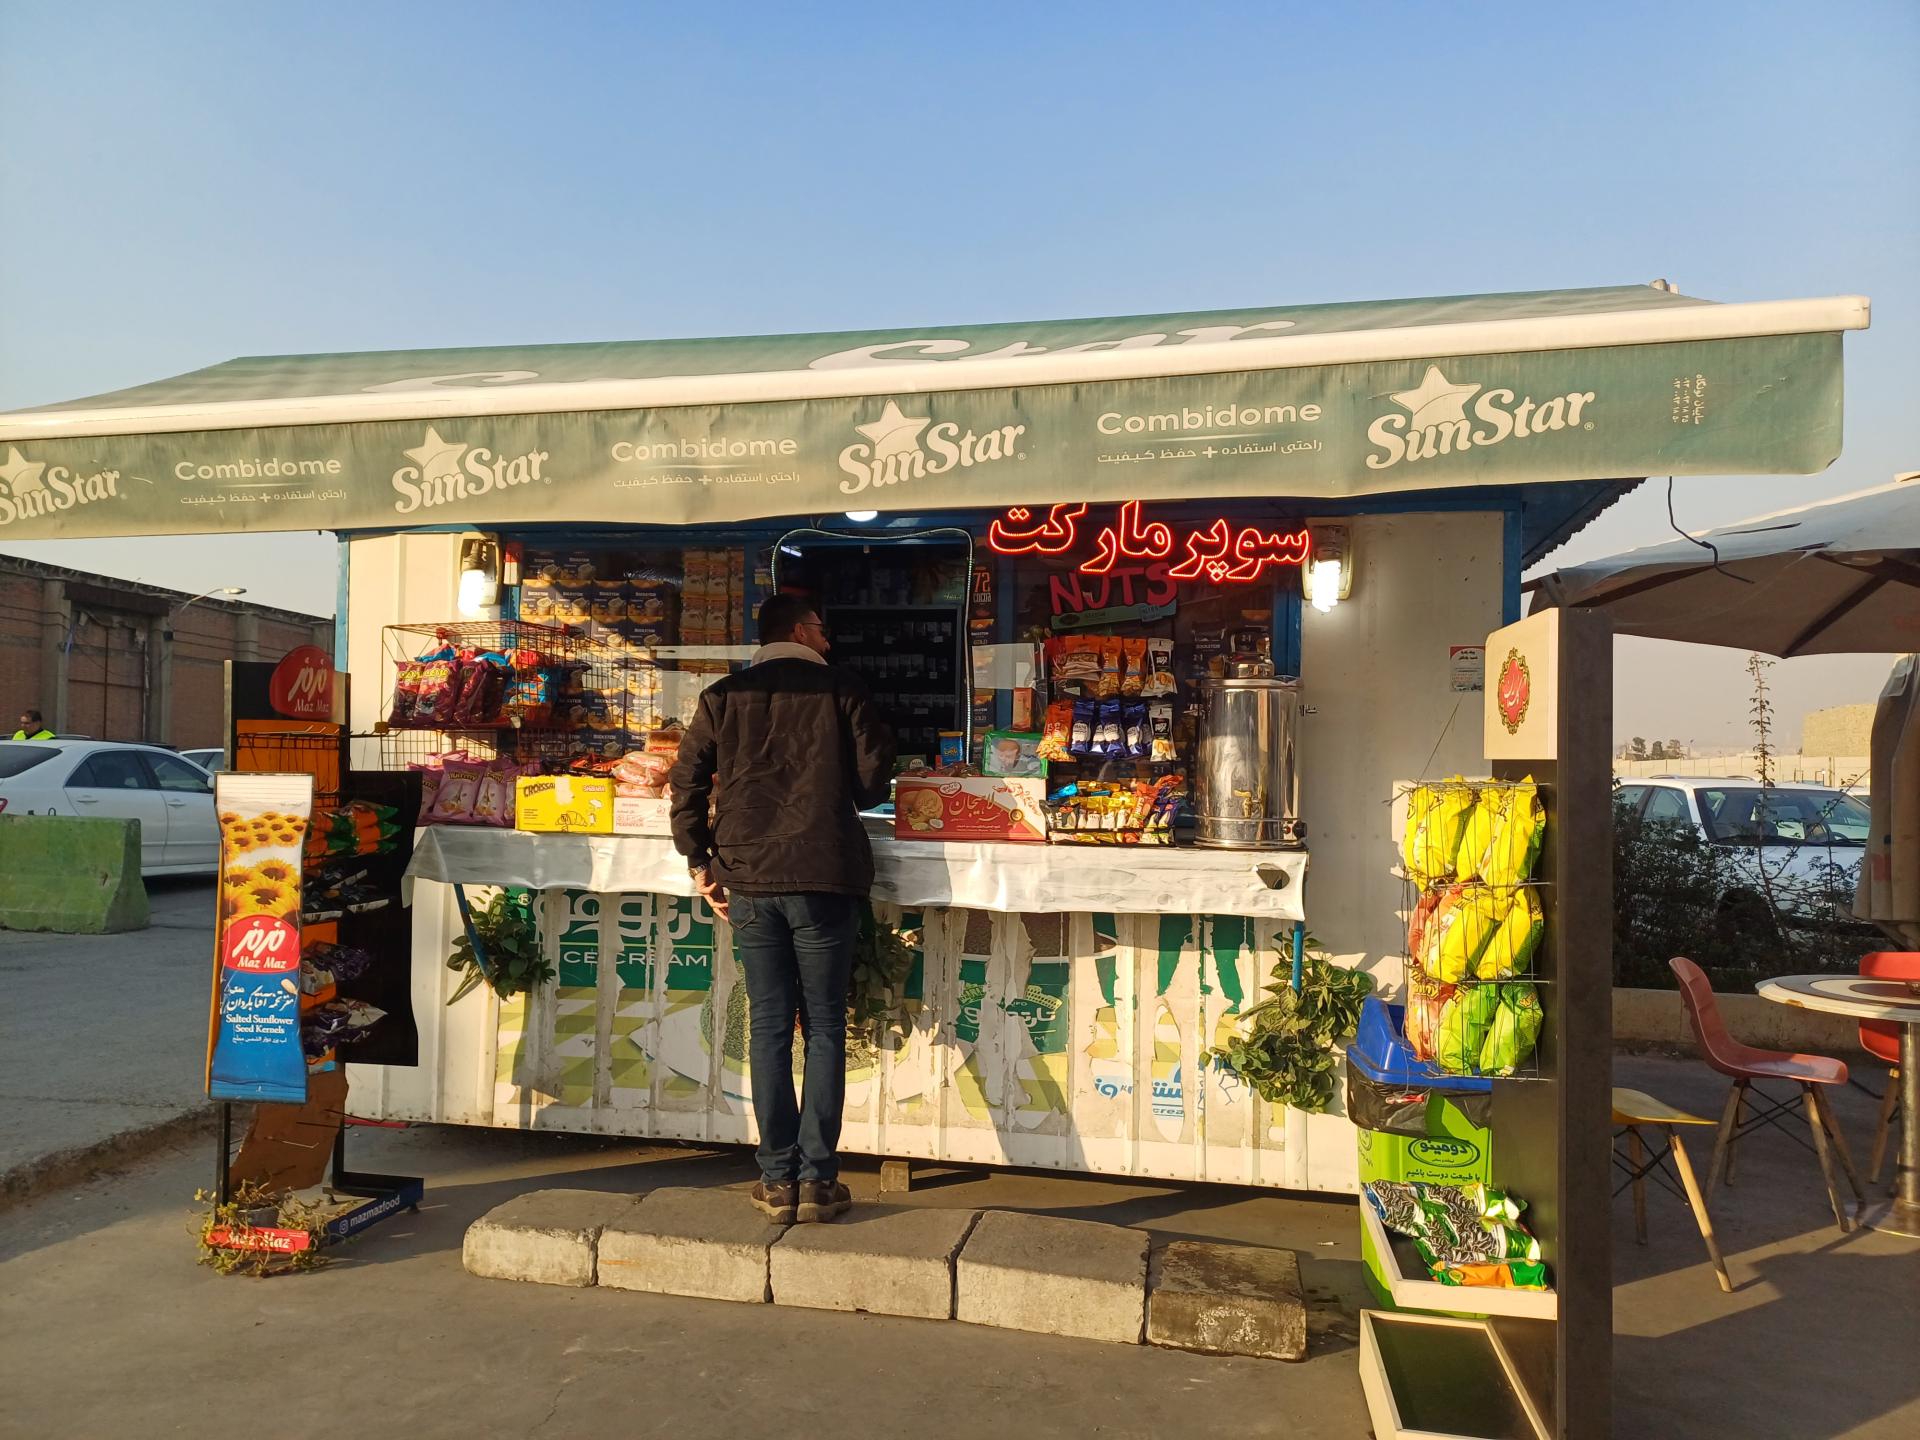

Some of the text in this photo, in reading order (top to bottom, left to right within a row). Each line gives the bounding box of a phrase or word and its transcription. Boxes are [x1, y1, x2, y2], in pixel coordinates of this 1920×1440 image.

[1097, 402, 1322, 435] Combidome
[1366, 388, 1595, 470] SunStar
[611, 437, 798, 463] Combidome
[1159, 445, 1197, 459] حفظ
[1221, 441, 1276, 456] استفاده
[1281, 440, 1323, 456] راحتی
[838, 421, 1025, 494] SunStar
[1097, 448, 1155, 464] کیفیت
[175, 457, 342, 481] Combidome
[392, 447, 549, 513] SunStar
[613, 475, 658, 488] کیفیت
[662, 473, 693, 485] حفظ
[715, 472, 762, 485] استفاده
[766, 471, 800, 484] راحتی
[180, 493, 226, 505] کیفیت
[229, 493, 256, 502] حفظ
[274, 490, 315, 501] استفاده
[317, 489, 347, 501] راحتی
[1168, 518, 1310, 582] سوپر
[294, 699, 314, 713] Maz
[237, 956, 287, 969] Maz Maz
[226, 1013, 294, 1025] Salted Sunflower
[235, 1024, 285, 1034] Seed Kernels
[1419, 1139, 1468, 1155] دومینو
